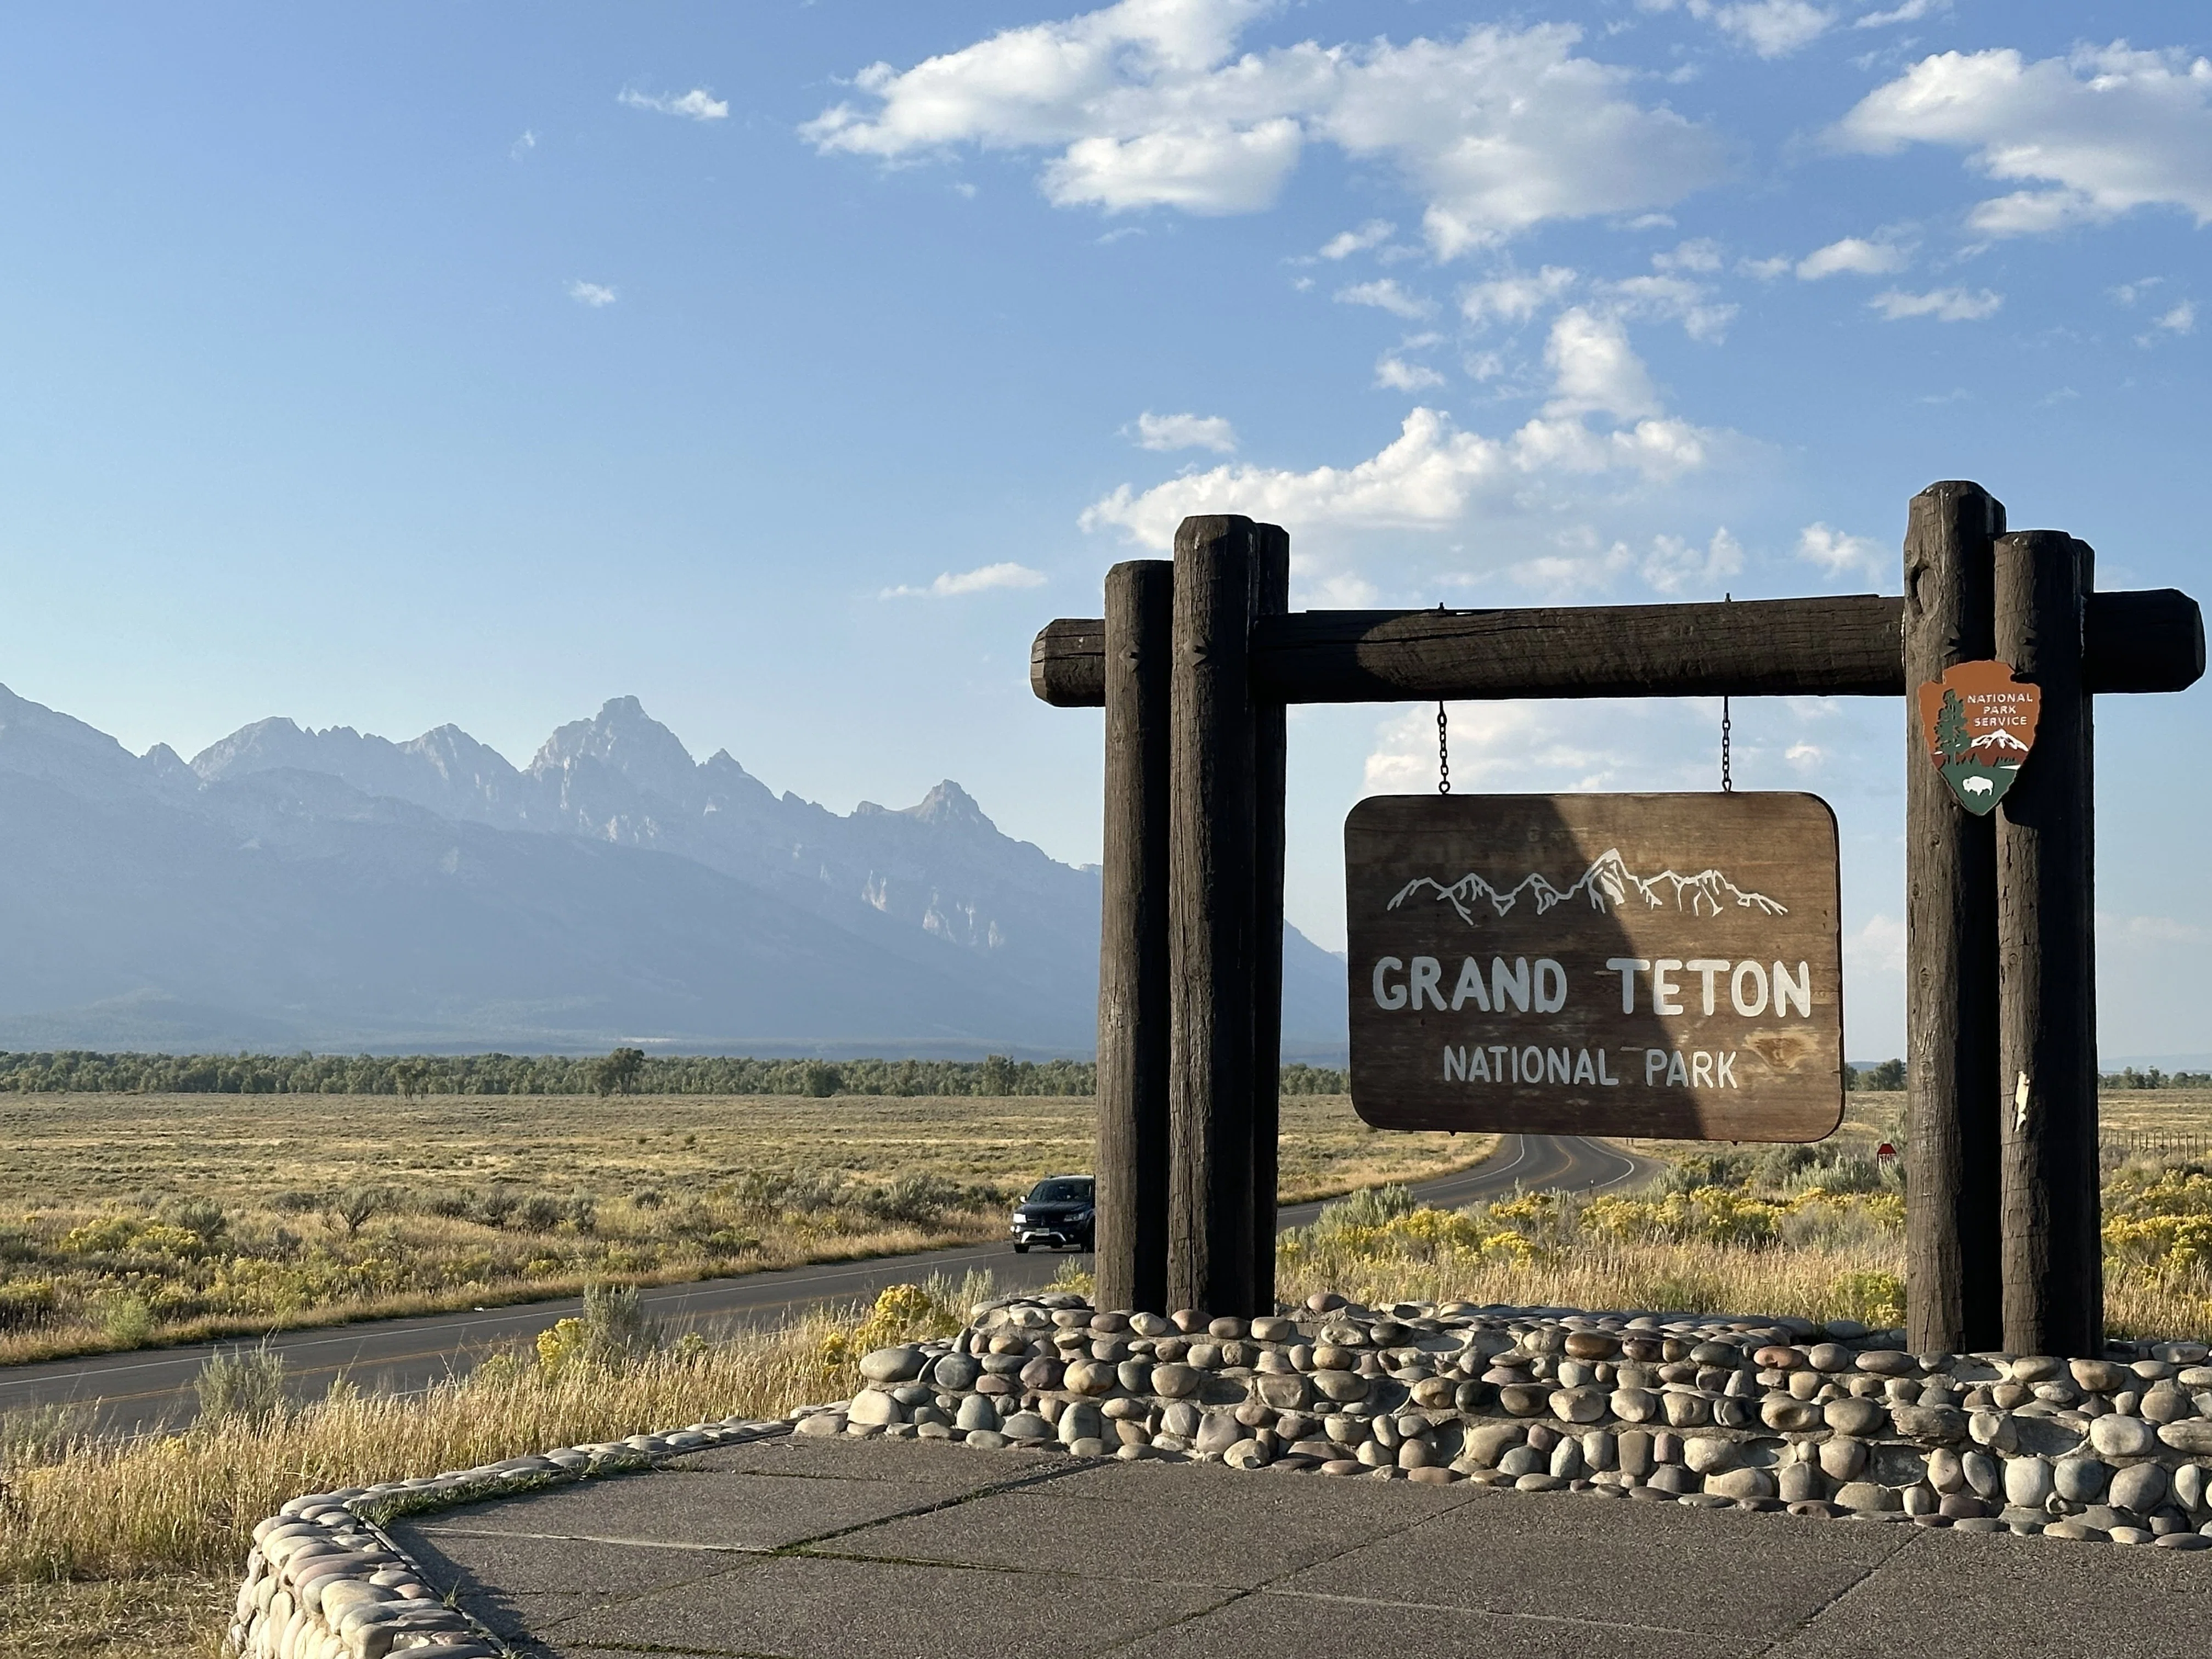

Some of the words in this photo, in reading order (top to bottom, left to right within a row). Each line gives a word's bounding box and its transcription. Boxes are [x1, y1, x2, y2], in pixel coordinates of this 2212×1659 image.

[1967, 693, 2033, 703] NATIONAL
[1983, 706, 2016, 714] PARK
[1974, 716, 2028, 727] SERVICE
[1373, 956, 1567, 1013] GRAND
[1607, 958, 1811, 1018] TETON
[1443, 1045, 1619, 1086] NATIONAL
[1646, 1048, 1738, 1089] PARK
